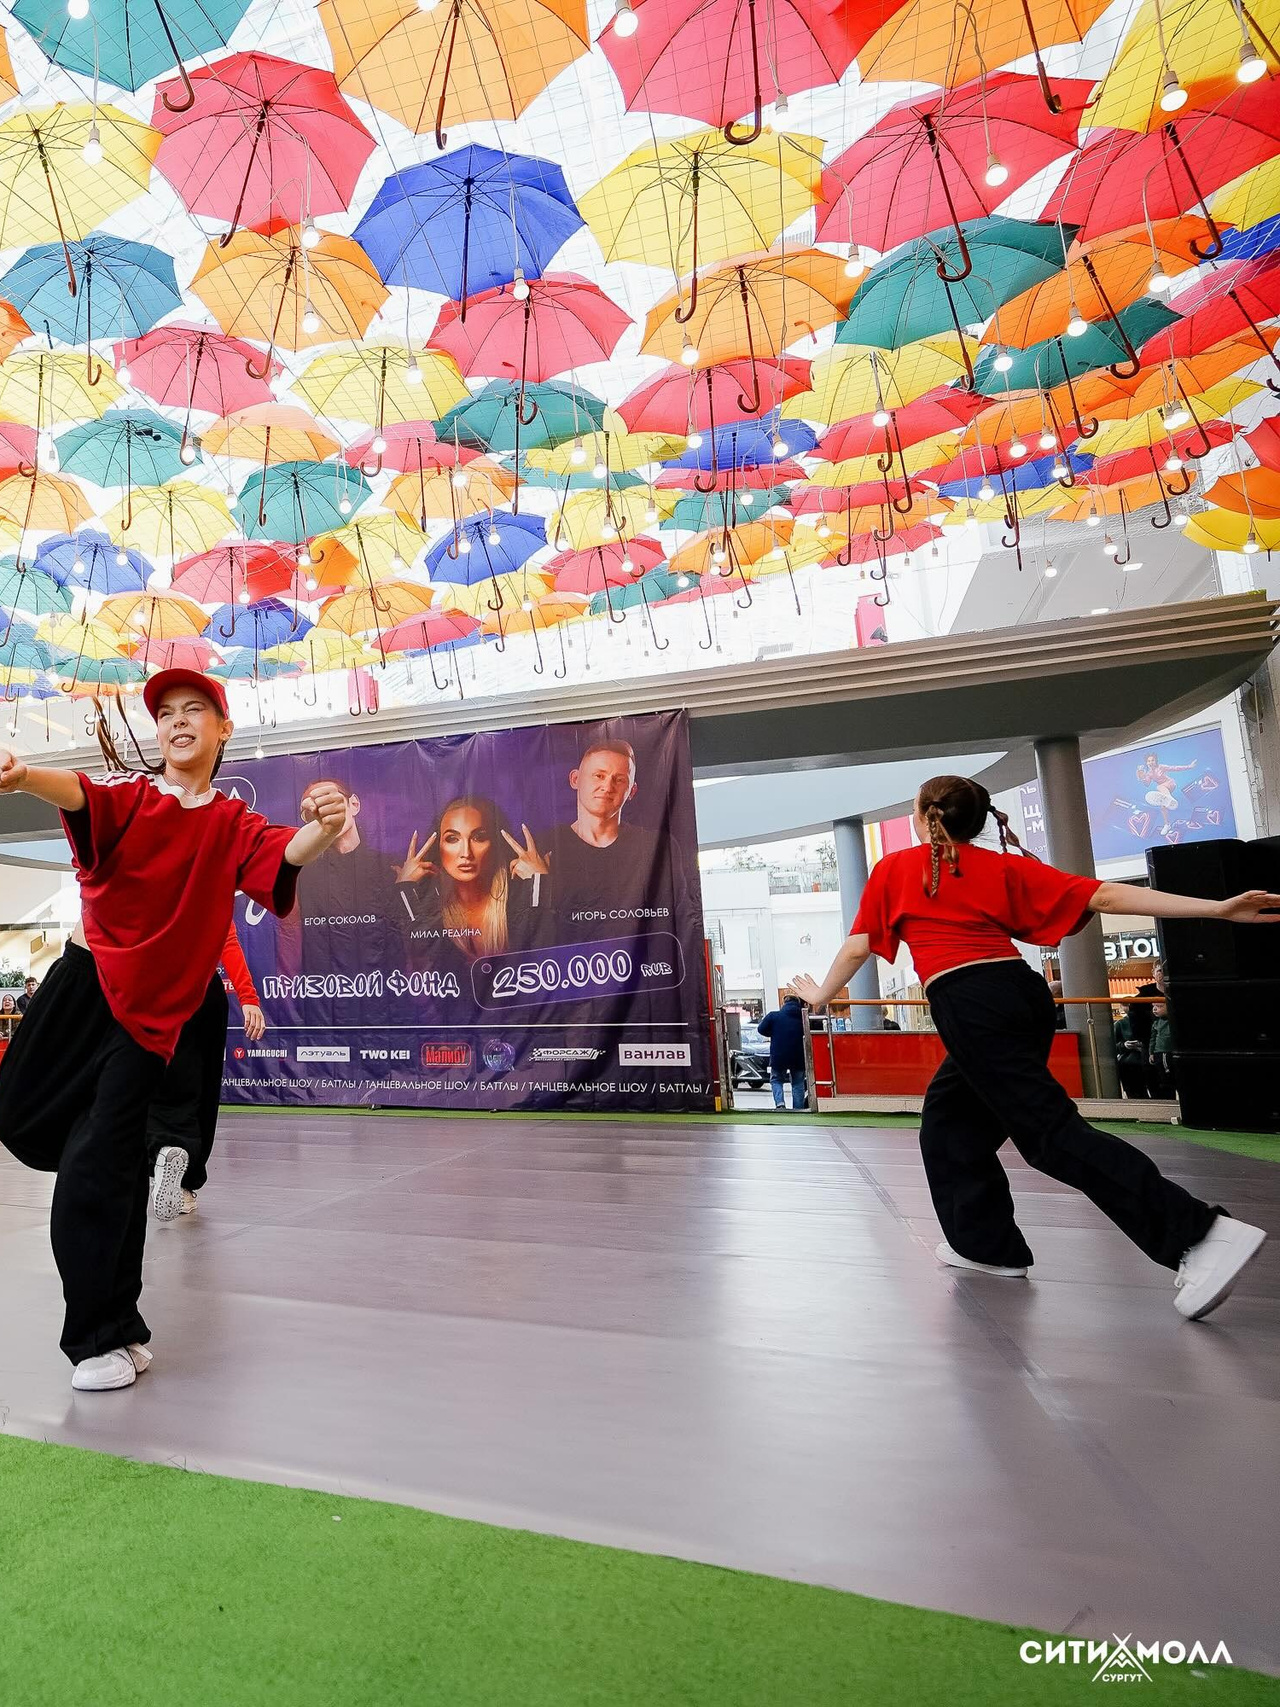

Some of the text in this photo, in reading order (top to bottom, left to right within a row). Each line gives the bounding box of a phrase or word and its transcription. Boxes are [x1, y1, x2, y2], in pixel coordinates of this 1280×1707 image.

[304, 914, 376, 926] ЕГОР СОКОЛОВ
[572, 907, 669, 921] ИГОРЬ СОЛОВЬЕВ
[410, 928, 482, 939] МИЛА РЕДИНА
[492, 949, 673, 998] 250.000 RUB
[263, 969, 460, 999] ПРИЗОВОЙ ФОНД
[247, 1049, 287, 1058] YAMAGUCHI
[360, 1050, 410, 1060] TWO KEI
[623, 1048, 686, 1060] ванлав
[221, 1078, 287, 1087] АНЦЕВАЛЬНОЕ
[289, 1079, 313, 1087] ШОУ
[322, 1080, 356, 1088] БАТТЛЫ
[366, 1080, 442, 1090] ТАНЦЕВАЛЬНОЕ
[444, 1081, 470, 1090] ШОУ
[480, 1082, 518, 1091] БАТТЛЫ
[529, 1082, 616, 1092] ТАНЦЕВАЛЬНОЕ
[619, 1083, 648, 1092] ШОУ
[660, 1084, 702, 1093] БАТТЛЫ
